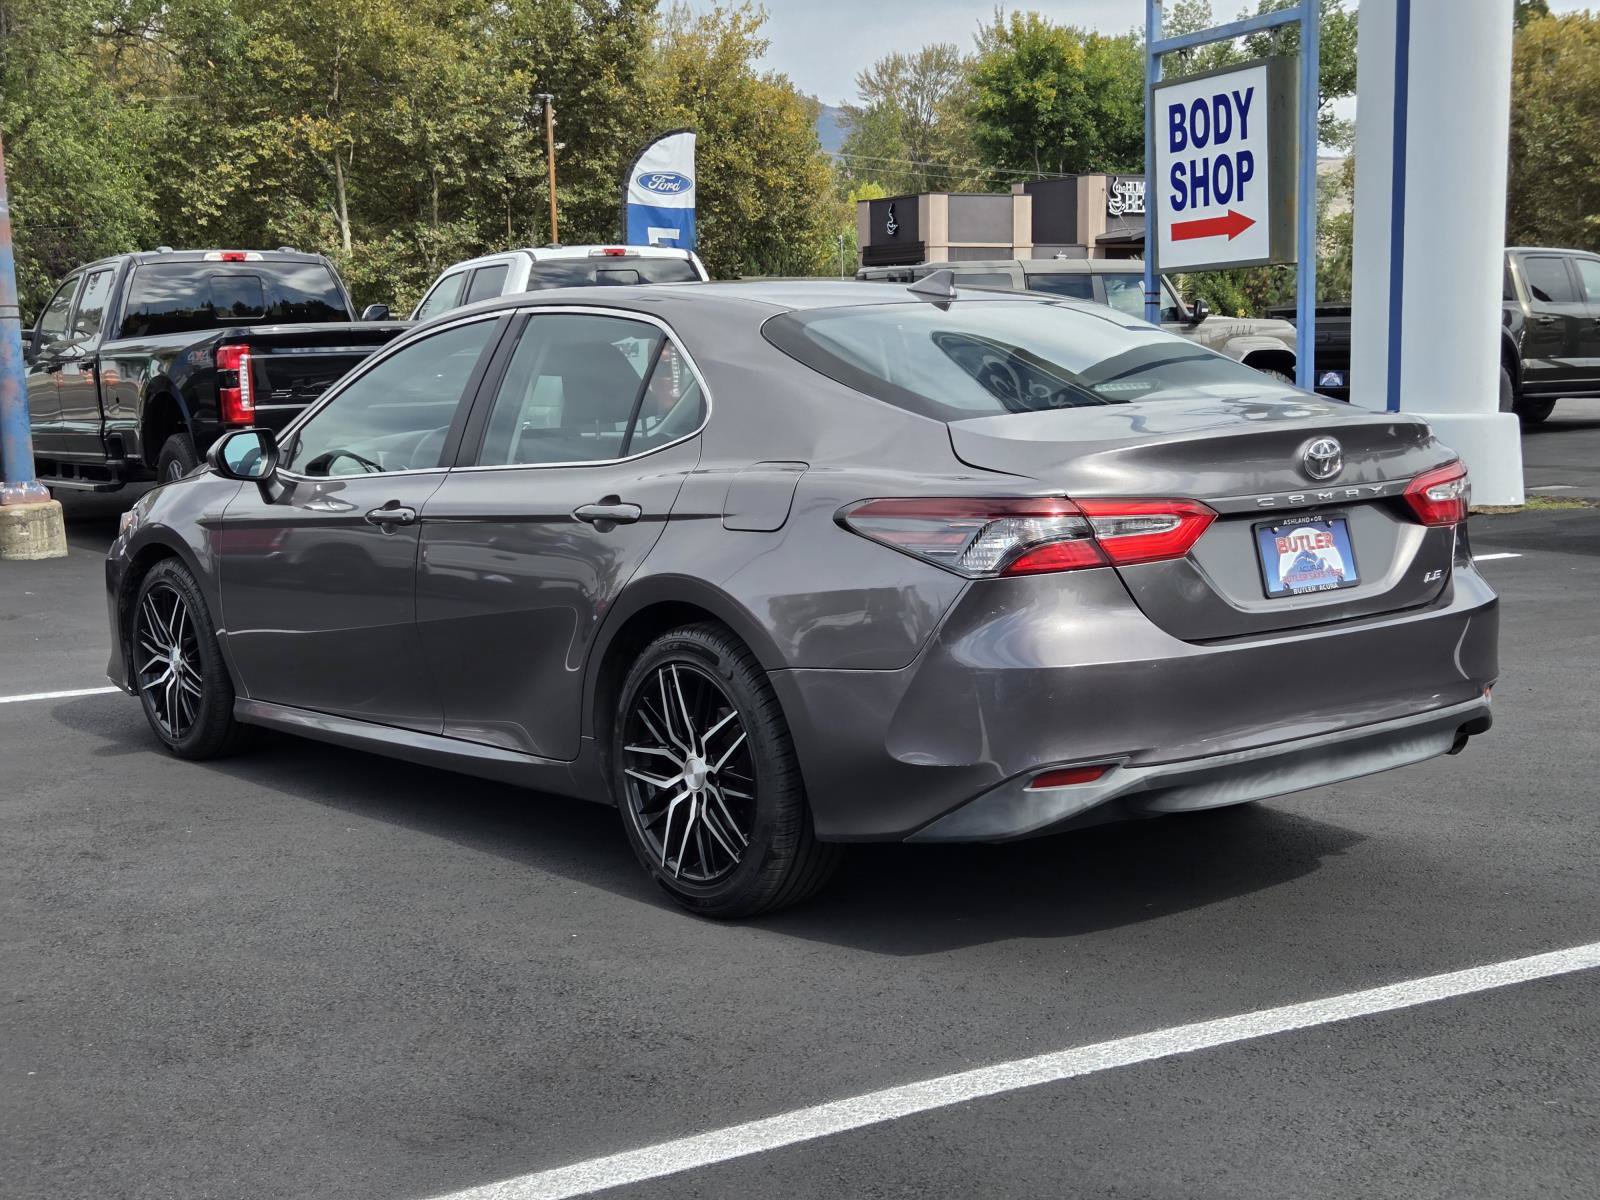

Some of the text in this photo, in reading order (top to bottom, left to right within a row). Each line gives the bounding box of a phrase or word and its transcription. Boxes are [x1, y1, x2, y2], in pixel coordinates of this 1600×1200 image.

[1168, 87, 1254, 153] BODY
[648, 174, 681, 192] Ford
[1170, 150, 1254, 212] SHOP
[1257, 485, 1384, 507] CAMRY
[1283, 516, 1310, 526] ASHLAND
[1275, 531, 1333, 554] BUTLER
[1424, 569, 1442, 583] LE
[1293, 582, 1339, 595] BUTLER ACURA
